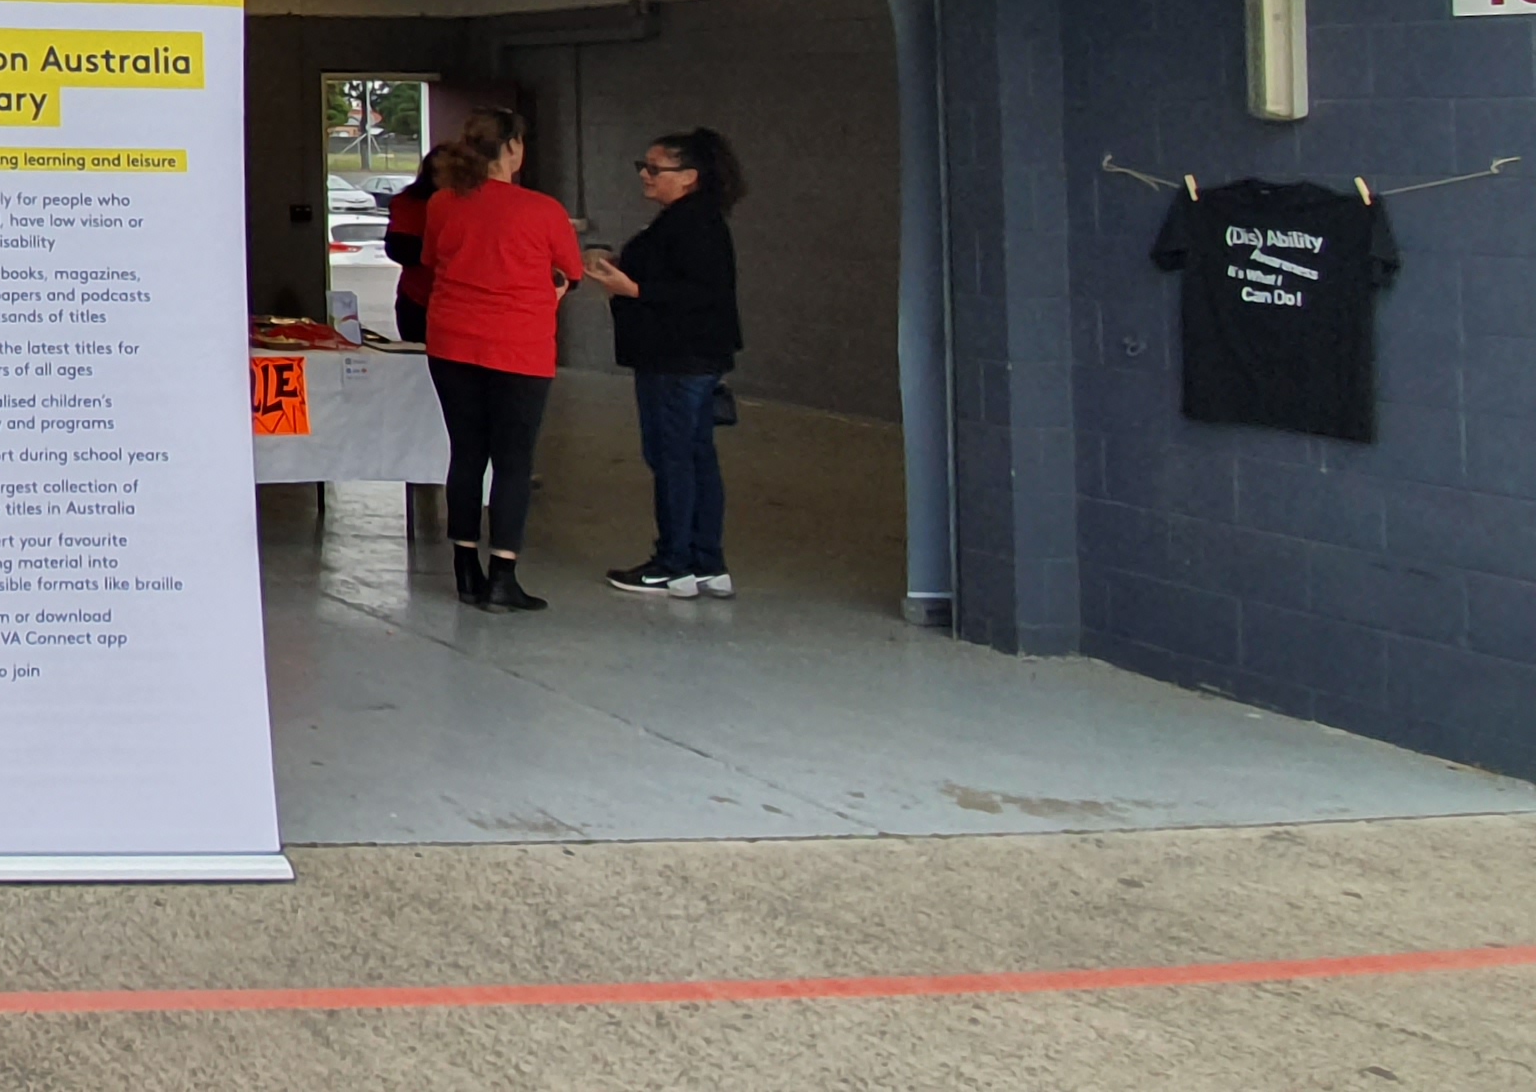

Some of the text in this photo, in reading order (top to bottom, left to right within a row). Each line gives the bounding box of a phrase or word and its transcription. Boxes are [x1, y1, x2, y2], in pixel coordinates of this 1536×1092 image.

[40, 44, 191, 74] Australia
[23, 152, 86, 171] learning
[90, 153, 122, 167] and
[126, 152, 177, 168] leisure
[16, 191, 38, 206] for
[42, 192, 93, 210] people
[97, 193, 131, 207] who
[9, 213, 45, 227] have
[49, 213, 76, 228] low
[80, 214, 123, 228] vision
[128, 218, 144, 228] or
[1226, 225, 1323, 253] (Dis) Ability
[0, 266, 48, 281] books,
[54, 266, 141, 285] magazines,
[46, 287, 76, 302] and
[80, 288, 151, 306] podcasts
[1241, 286, 1272, 304] Can
[48, 308, 64, 323] of
[68, 308, 107, 324] titles
[27, 340, 70, 355] latest
[74, 340, 113, 355] titles
[117, 340, 140, 354] for
[14, 362, 30, 377] of
[34, 362, 52, 376] all
[56, 366, 93, 380] ages
[6, 416, 36, 430] and
[40, 419, 115, 434] programs
[19, 448, 68, 466] during
[73, 447, 123, 461] school
[127, 451, 169, 465] years
[43, 479, 118, 494] collection
[122, 479, 139, 494] of
[5, 501, 43, 516] titles
[47, 502, 61, 515] in
[65, 501, 135, 515] Australia
[19, 537, 53, 552] your
[58, 533, 128, 548] favourite
[17, 554, 83, 569] material
[87, 555, 119, 569] into
[37, 576, 99, 591] formats
[104, 576, 130, 591] like
[135, 576, 183, 591] braille
[14, 613, 30, 624] or
[35, 609, 112, 624] download
[0, 631, 22, 645] VA
[25, 631, 92, 646] Connect
[96, 635, 128, 649] app
[11, 664, 41, 682] join
